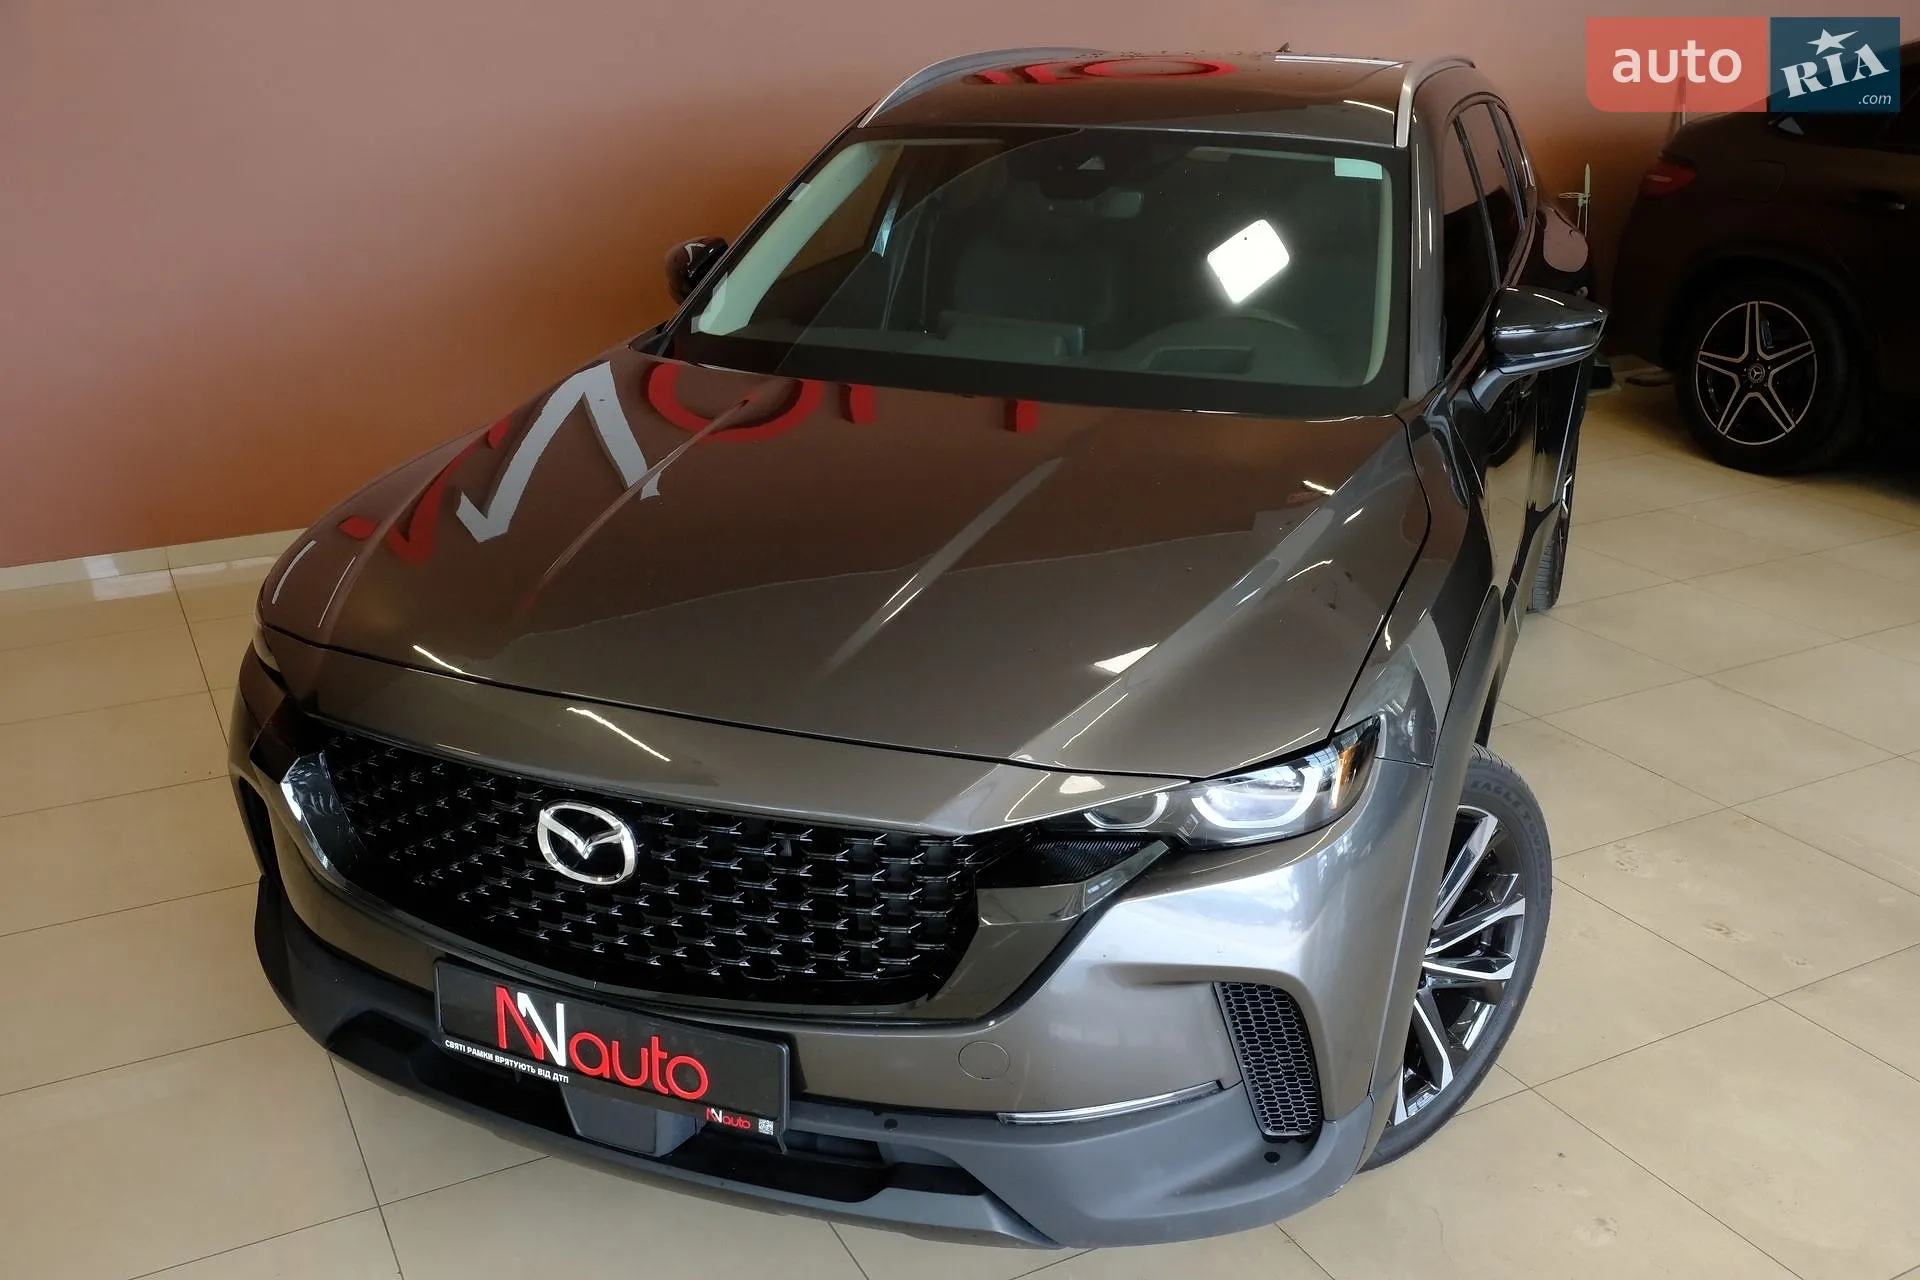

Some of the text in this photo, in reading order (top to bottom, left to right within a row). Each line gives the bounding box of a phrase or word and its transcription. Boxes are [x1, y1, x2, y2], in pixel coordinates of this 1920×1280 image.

[445, 1039, 569, 1084] СВЯТІ РАМКИ ВРЯТУЮТЬ ВІД ДТП
